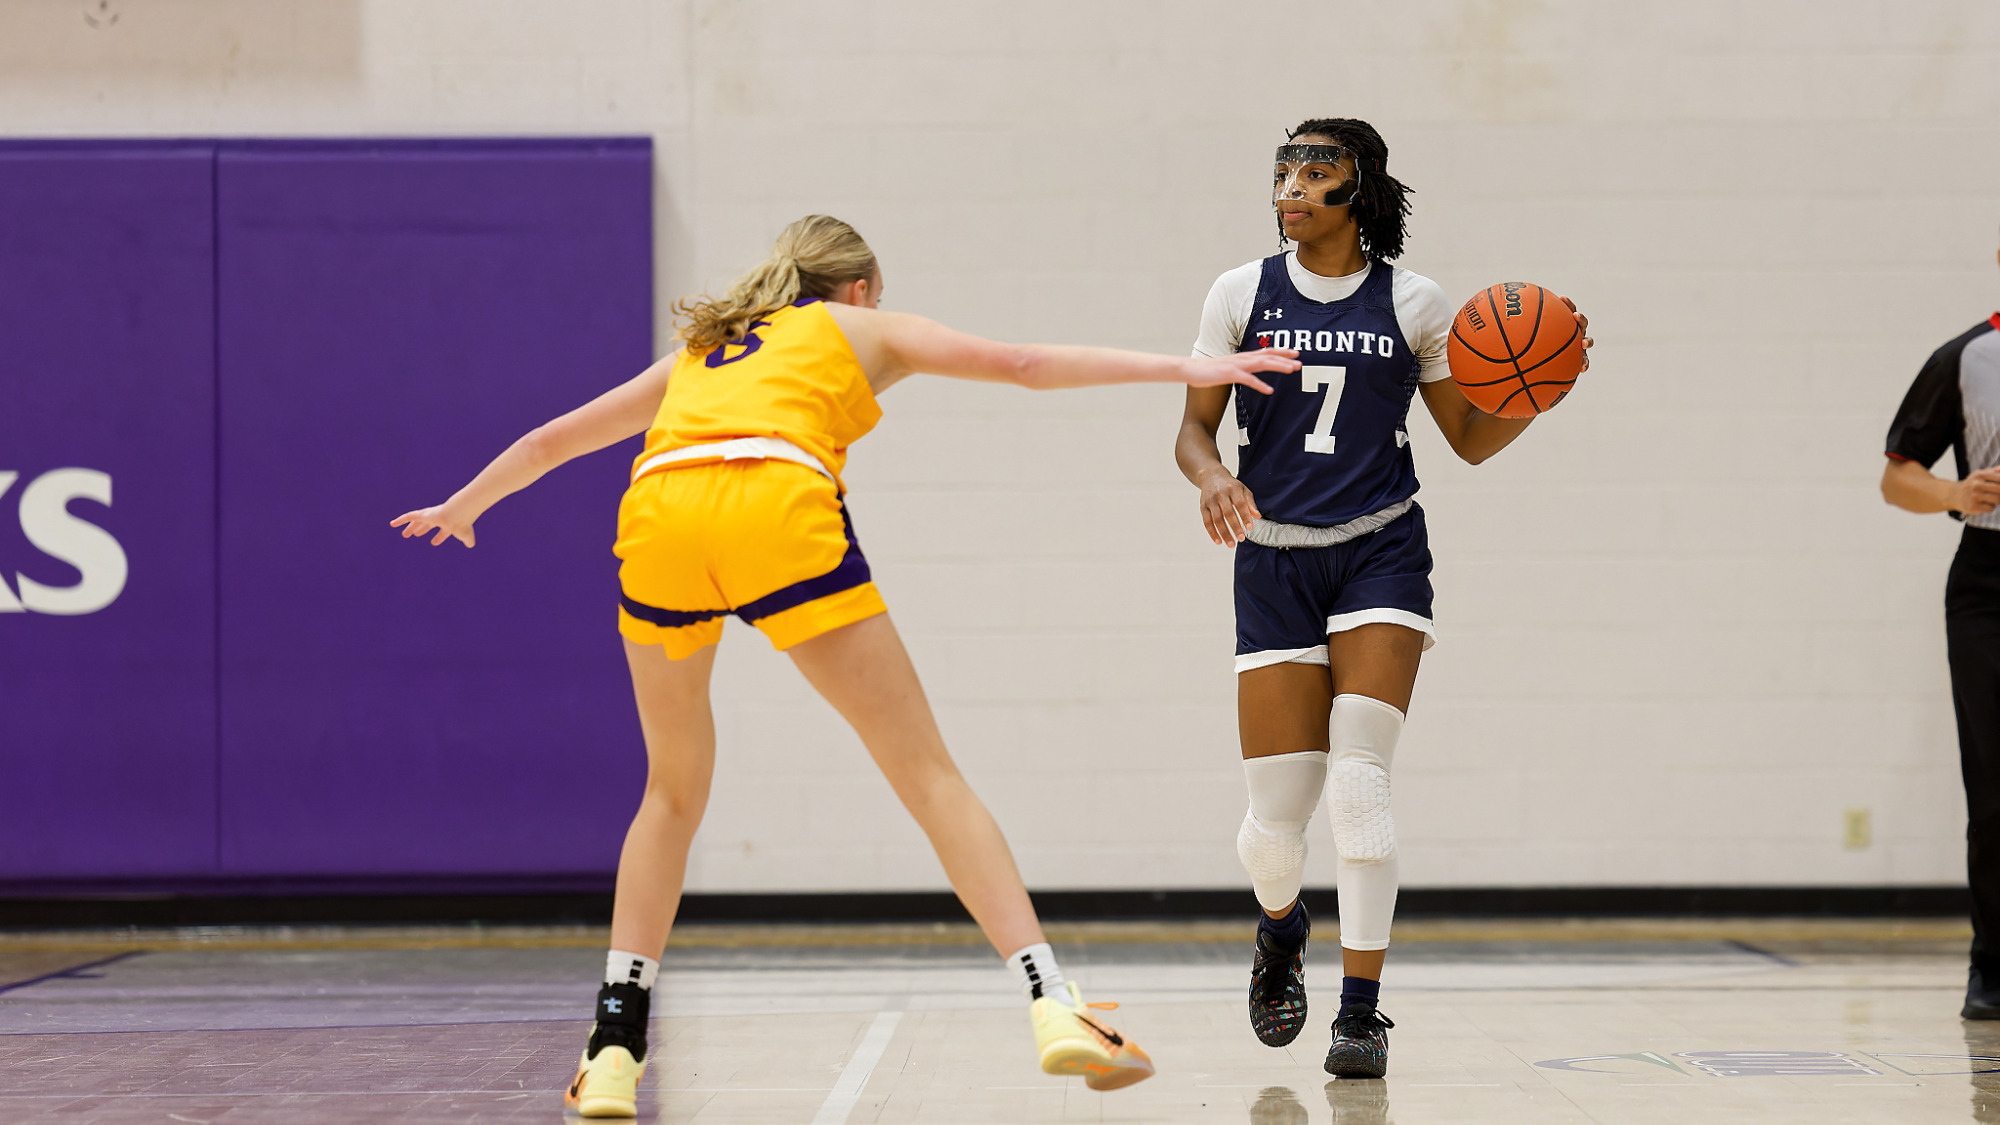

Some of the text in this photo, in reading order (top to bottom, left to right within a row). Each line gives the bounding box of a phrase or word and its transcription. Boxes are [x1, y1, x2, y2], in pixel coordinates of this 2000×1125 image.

[1503, 282, 1527, 318] lson
[1256, 329, 1395, 359] TORONTO
[1302, 366, 1347, 454] 7
[0, 467, 128, 615] S
